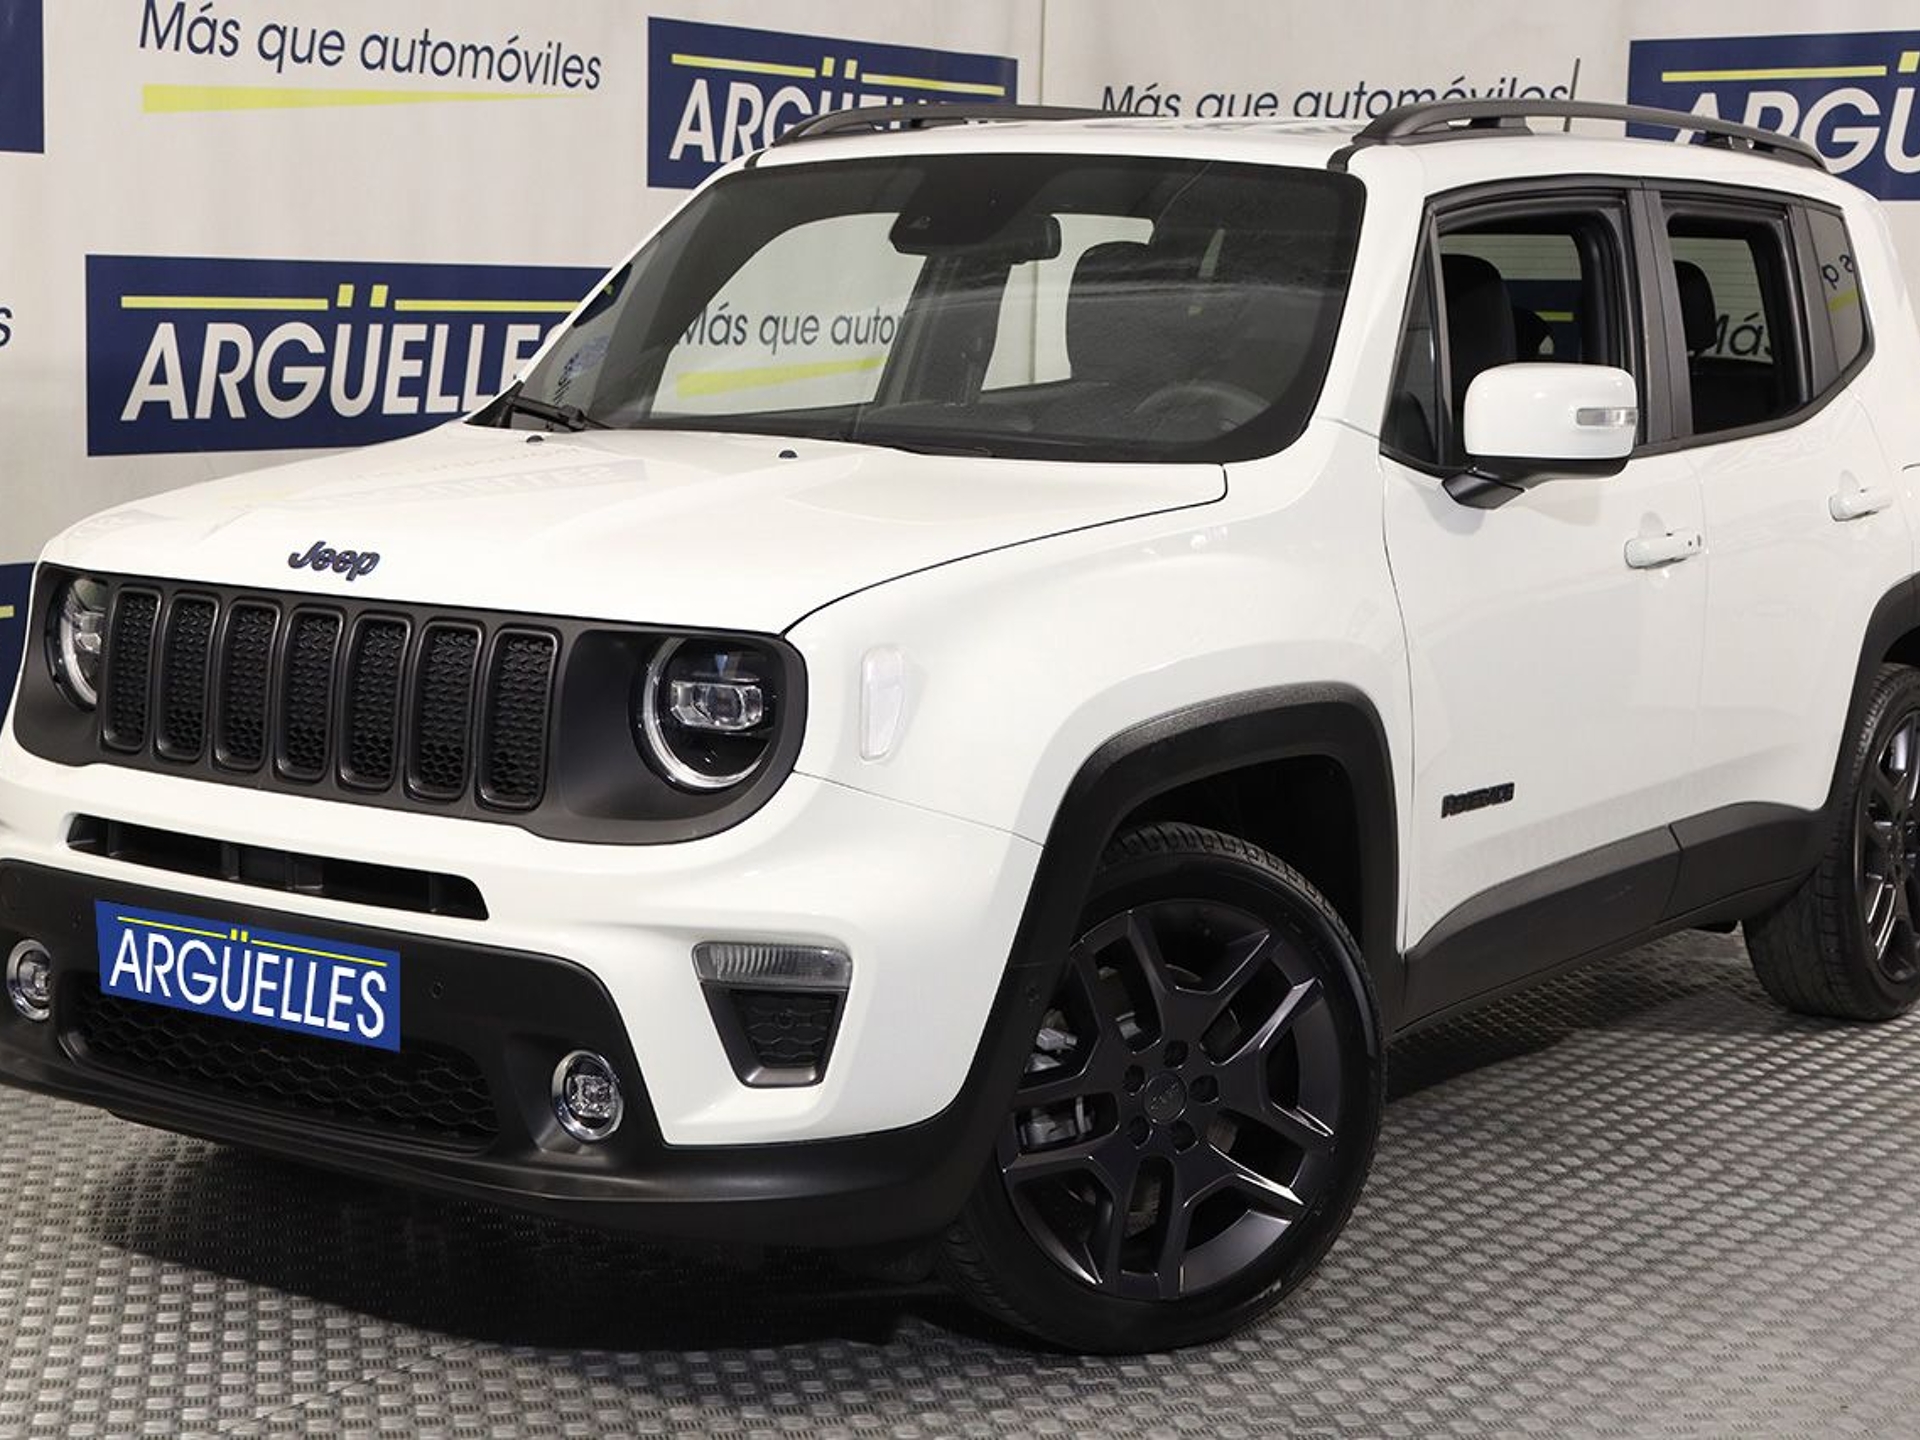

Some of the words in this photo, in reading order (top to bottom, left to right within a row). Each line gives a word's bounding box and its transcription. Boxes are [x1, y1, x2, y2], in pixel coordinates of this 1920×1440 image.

[139, 0, 241, 57] Más
[258, 23, 345, 74] que
[359, 28, 602, 90] automóviles
[759, 315, 820, 355] que
[288, 540, 381, 581] Jeep
[109, 928, 387, 1039] ARGÜELLES
